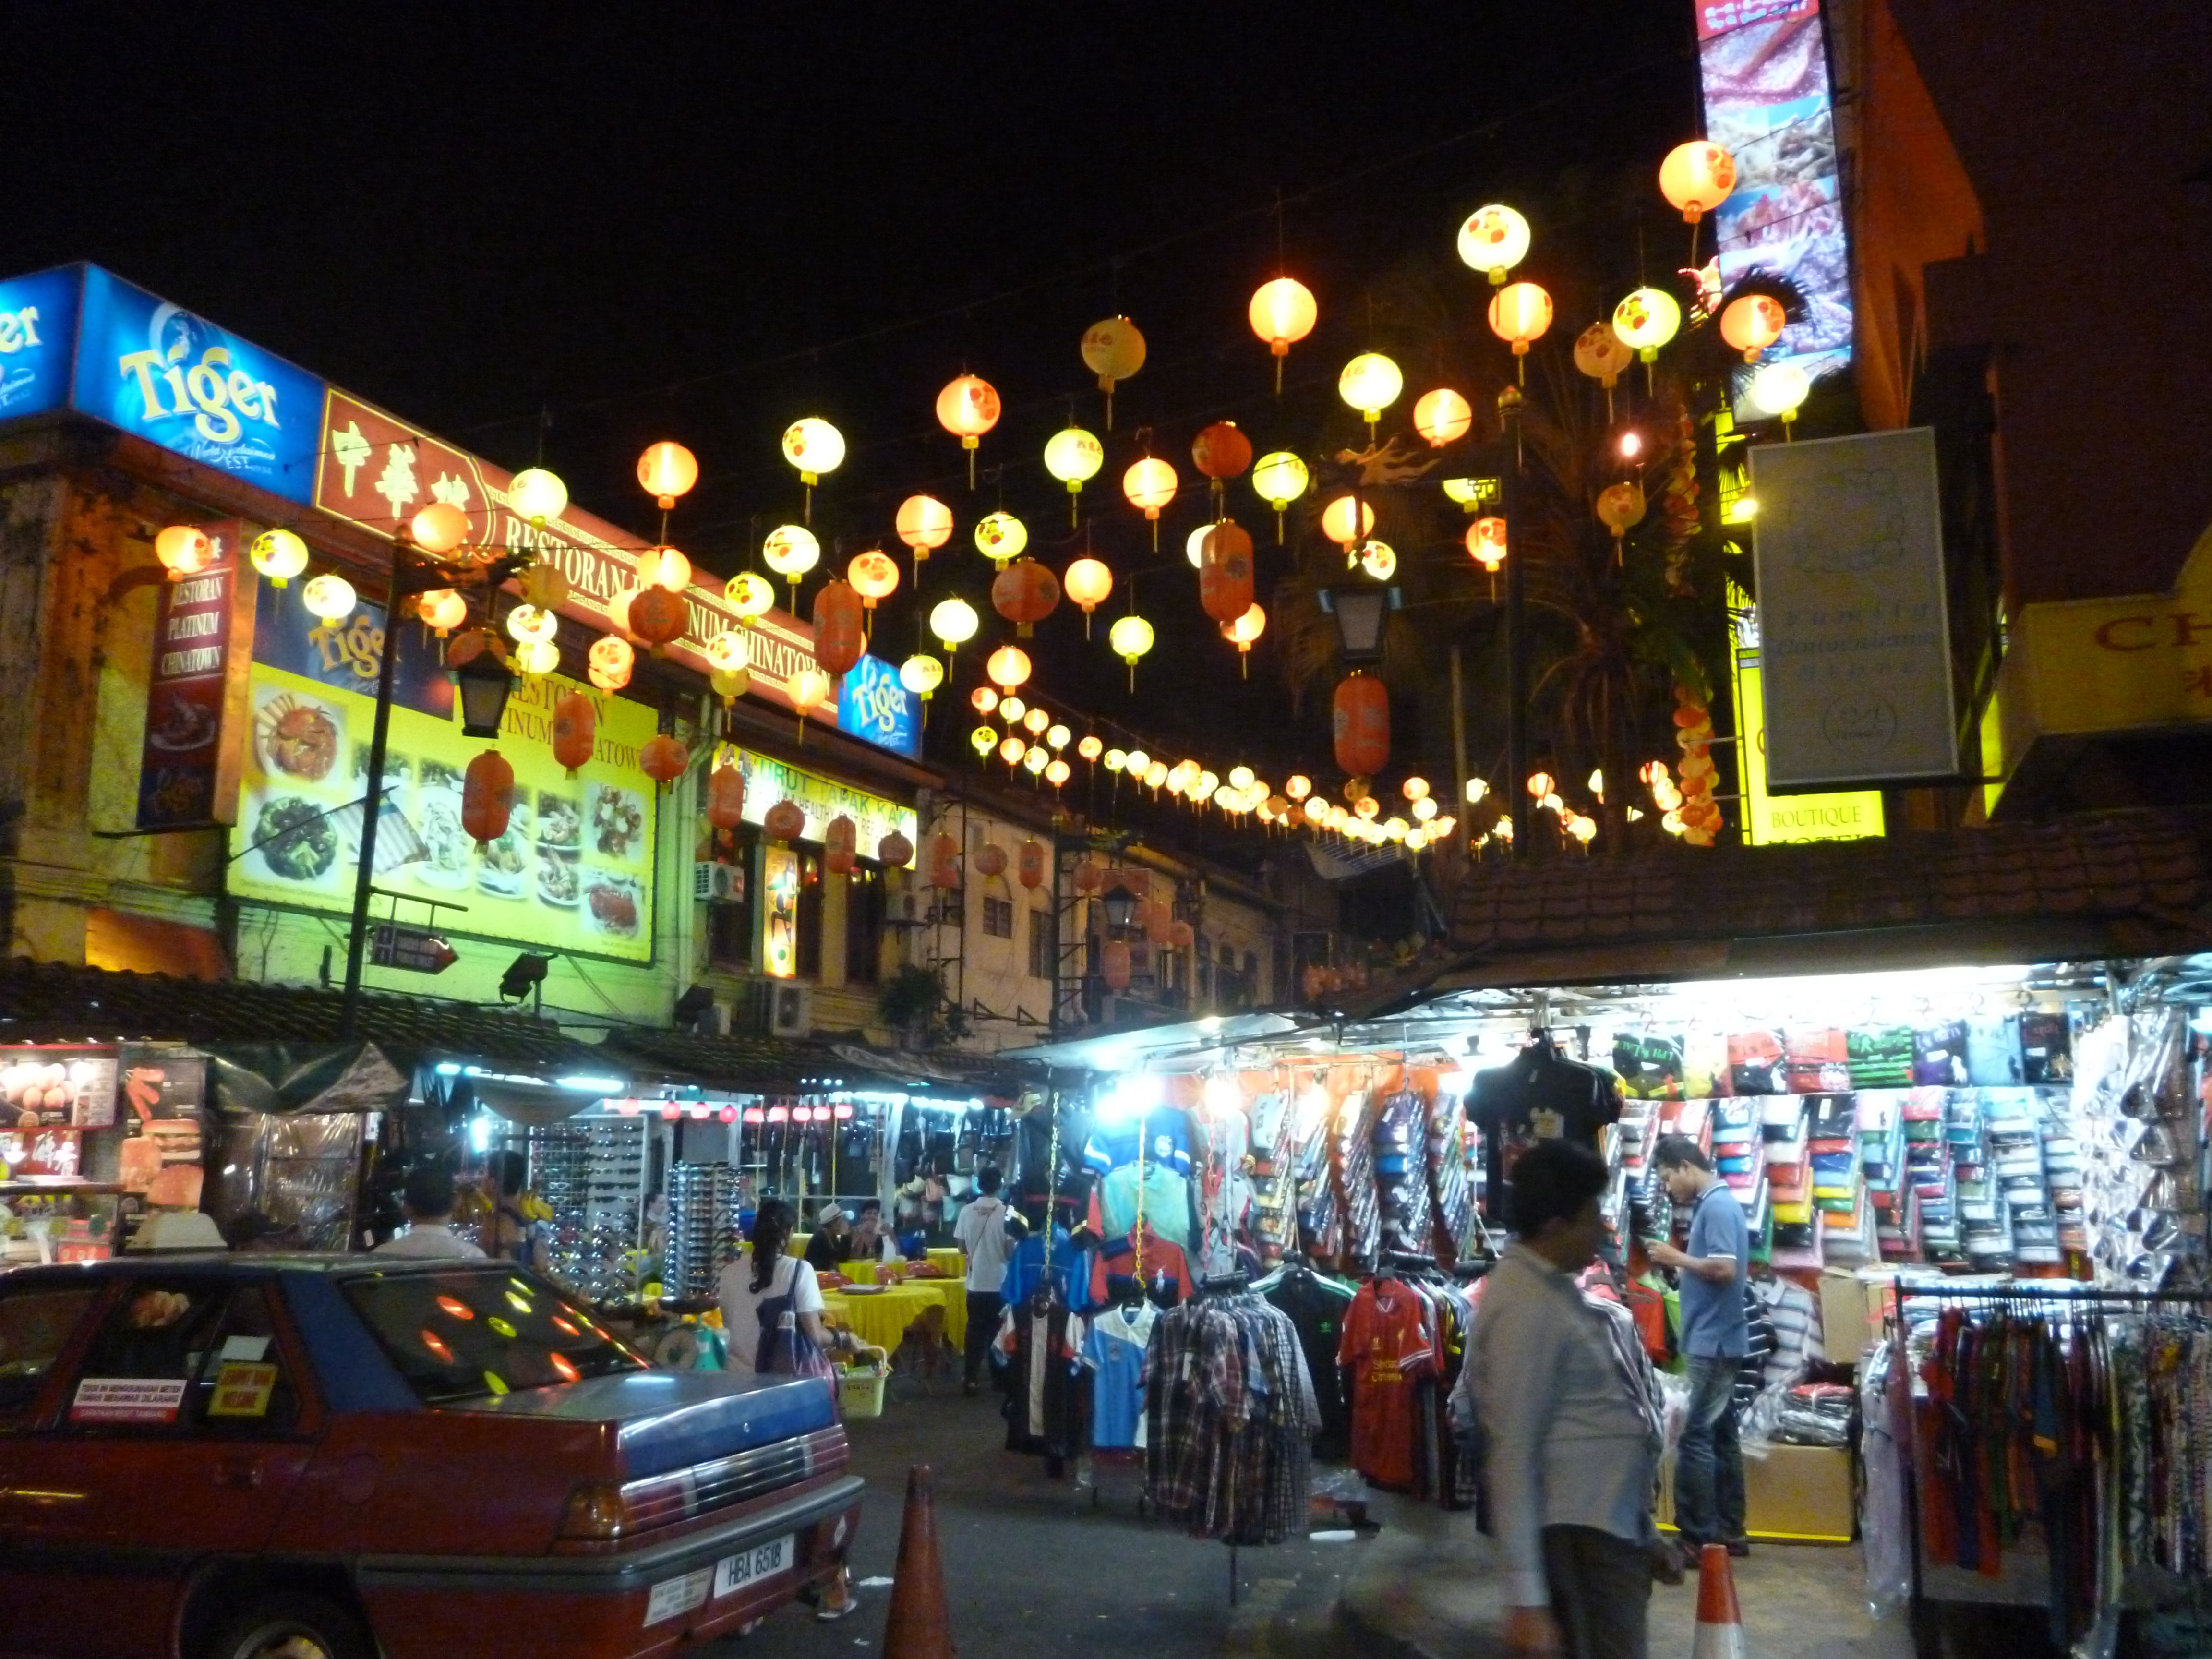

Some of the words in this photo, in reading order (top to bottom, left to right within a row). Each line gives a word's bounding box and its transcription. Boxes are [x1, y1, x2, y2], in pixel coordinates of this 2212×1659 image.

[120, 347, 281, 444] Tiger
[308, 615, 401, 678] Tige
[852, 673, 908, 732] Tiger
[759, 758, 811, 794] URUT
[818, 781, 870, 816] TAPAK
[799, 797, 836, 823] HEALTHY
[1771, 805, 1863, 829] BOUTIQUE
[728, 1552, 752, 1586] HBA
[755, 1542, 781, 1575] 6518
